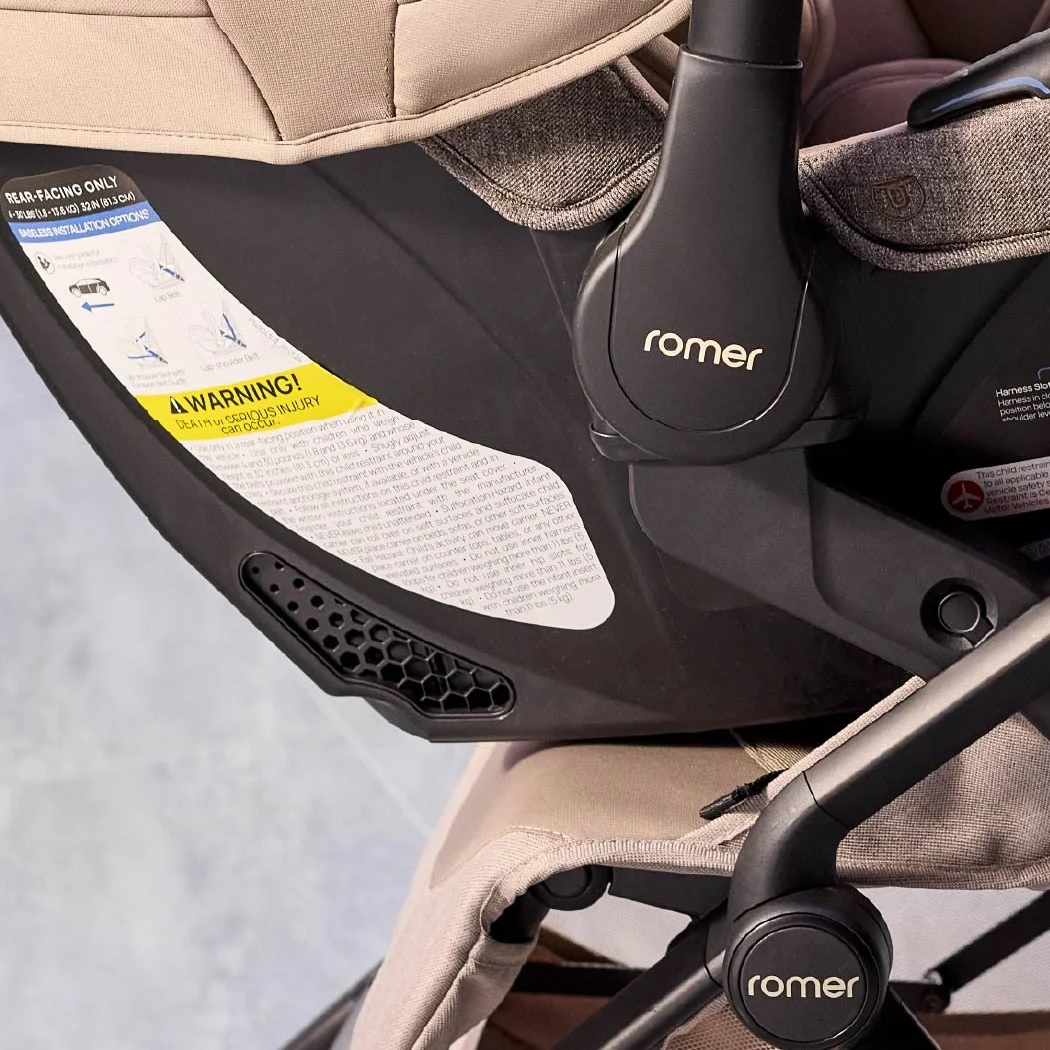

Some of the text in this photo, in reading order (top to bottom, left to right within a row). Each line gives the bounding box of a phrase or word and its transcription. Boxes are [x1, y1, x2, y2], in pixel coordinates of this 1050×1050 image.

[5, 175, 118, 204] REAR-FACING ONLY
[18, 209, 150, 238] BASELESS INSTALLATION OPTIONS
[644, 329, 763, 371] romer
[184, 373, 302, 413] WARNING!
[995, 384, 1033, 398] Harness
[225, 406, 277, 424] SERIOUS
[277, 394, 320, 415] INJURY
[997, 396, 1031, 407] Harness
[1000, 404, 1032, 417] position
[221, 418, 281, 435] can occur.
[976, 470, 996, 480] This
[996, 466, 1017, 478] child
[993, 477, 1004, 487] all
[1005, 472, 1049, 487] applicable
[1018, 481, 1045, 494] safety
[1011, 498, 1049, 510] Vehicles
[748, 974, 860, 999] romer
